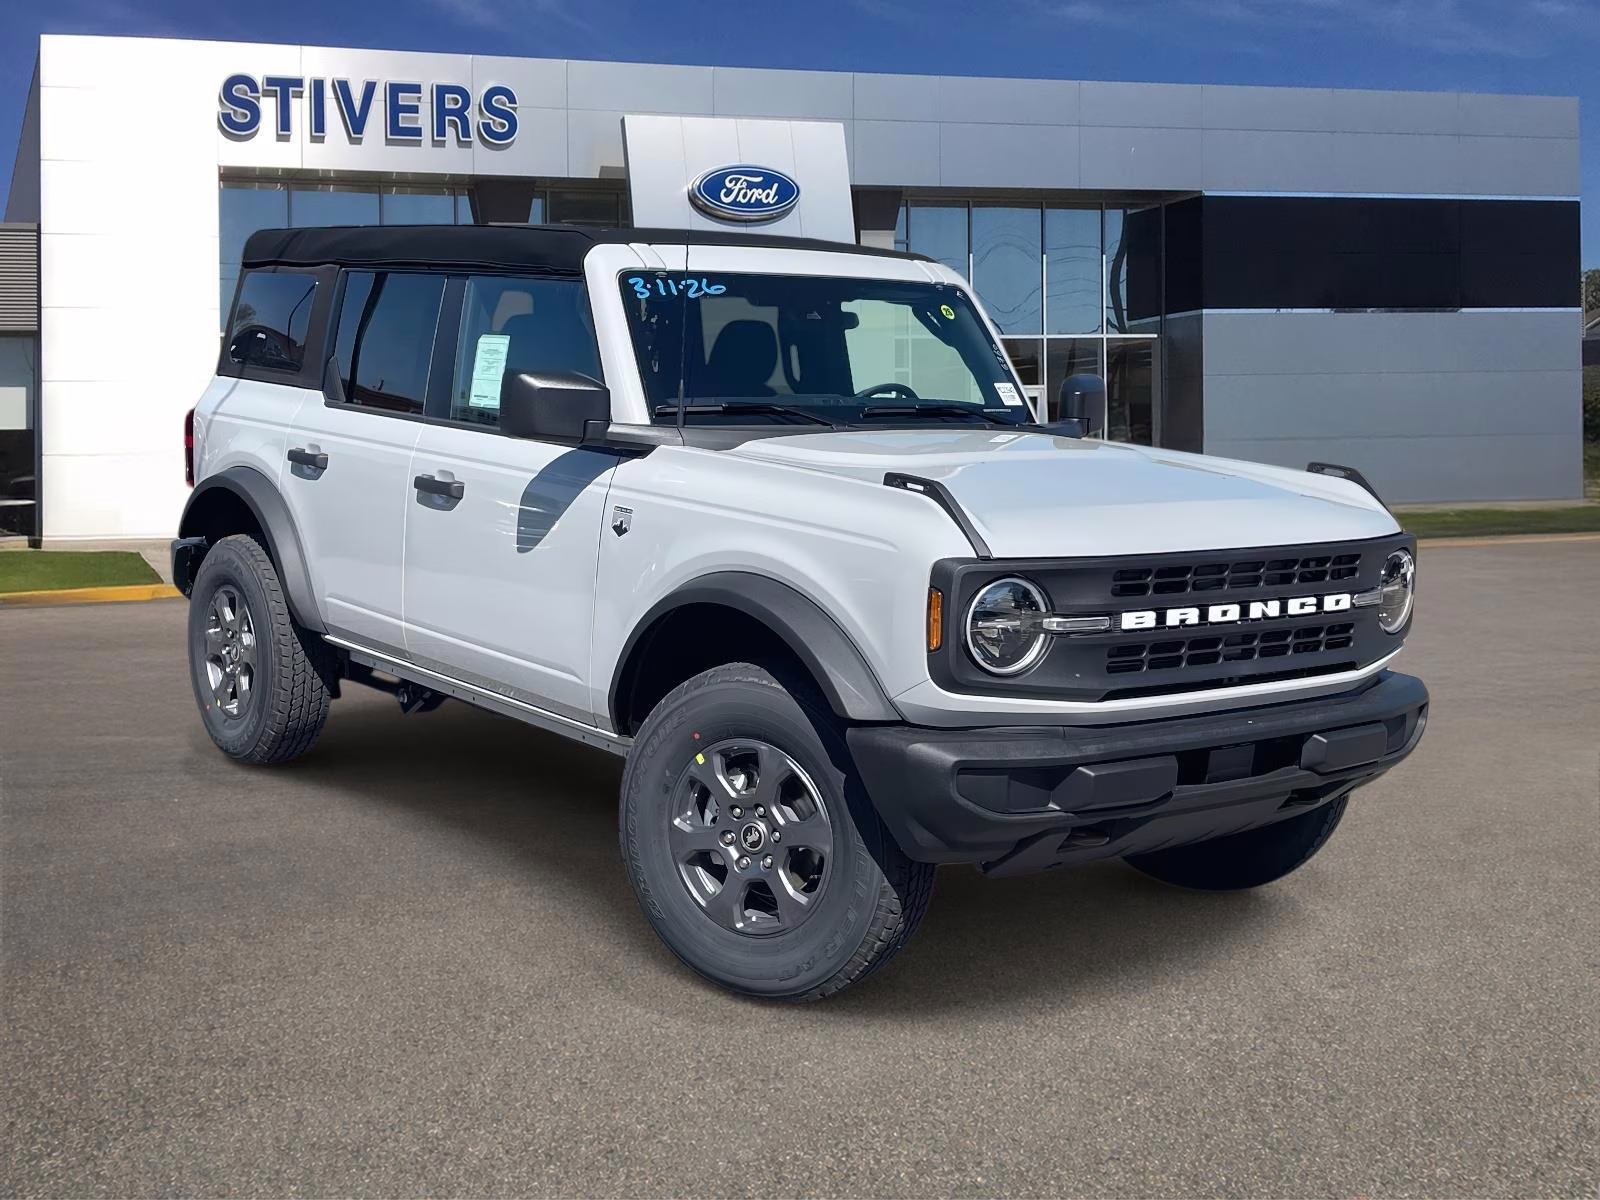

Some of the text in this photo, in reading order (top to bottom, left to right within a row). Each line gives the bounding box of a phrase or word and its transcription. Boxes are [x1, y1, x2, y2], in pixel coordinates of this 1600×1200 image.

[218, 73, 519, 149] STIVERS
[720, 174, 779, 204] Ford
[1121, 593, 1351, 630] BRONCO
